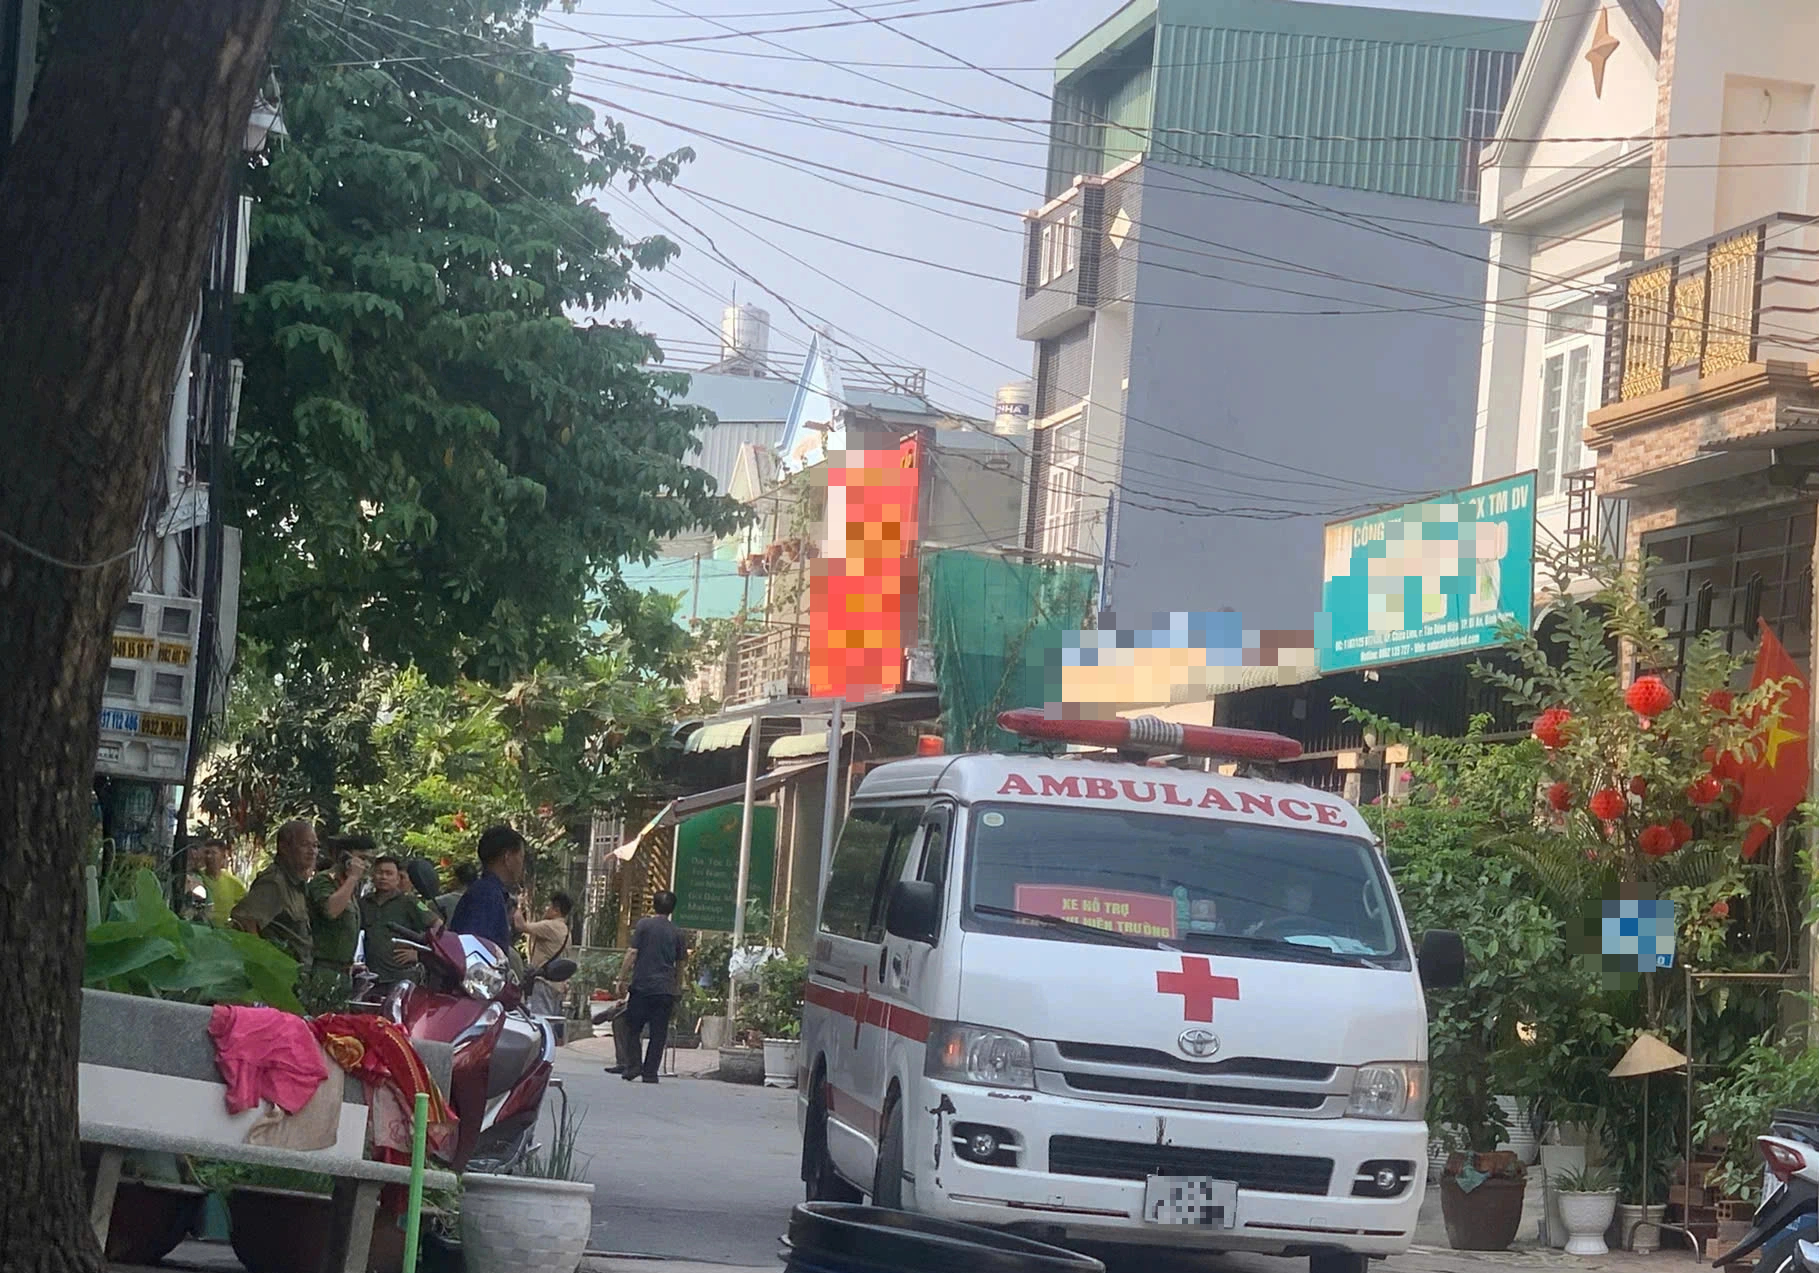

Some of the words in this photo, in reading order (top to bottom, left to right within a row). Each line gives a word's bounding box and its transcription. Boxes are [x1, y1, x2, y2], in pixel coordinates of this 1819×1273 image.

[1353, 521, 1385, 548] CÔNG
[1489, 489, 1508, 517] TM
[1512, 484, 1529, 511] DV
[997, 773, 1348, 828] AMBULANCE
[1062, 898, 1079, 911] XE
